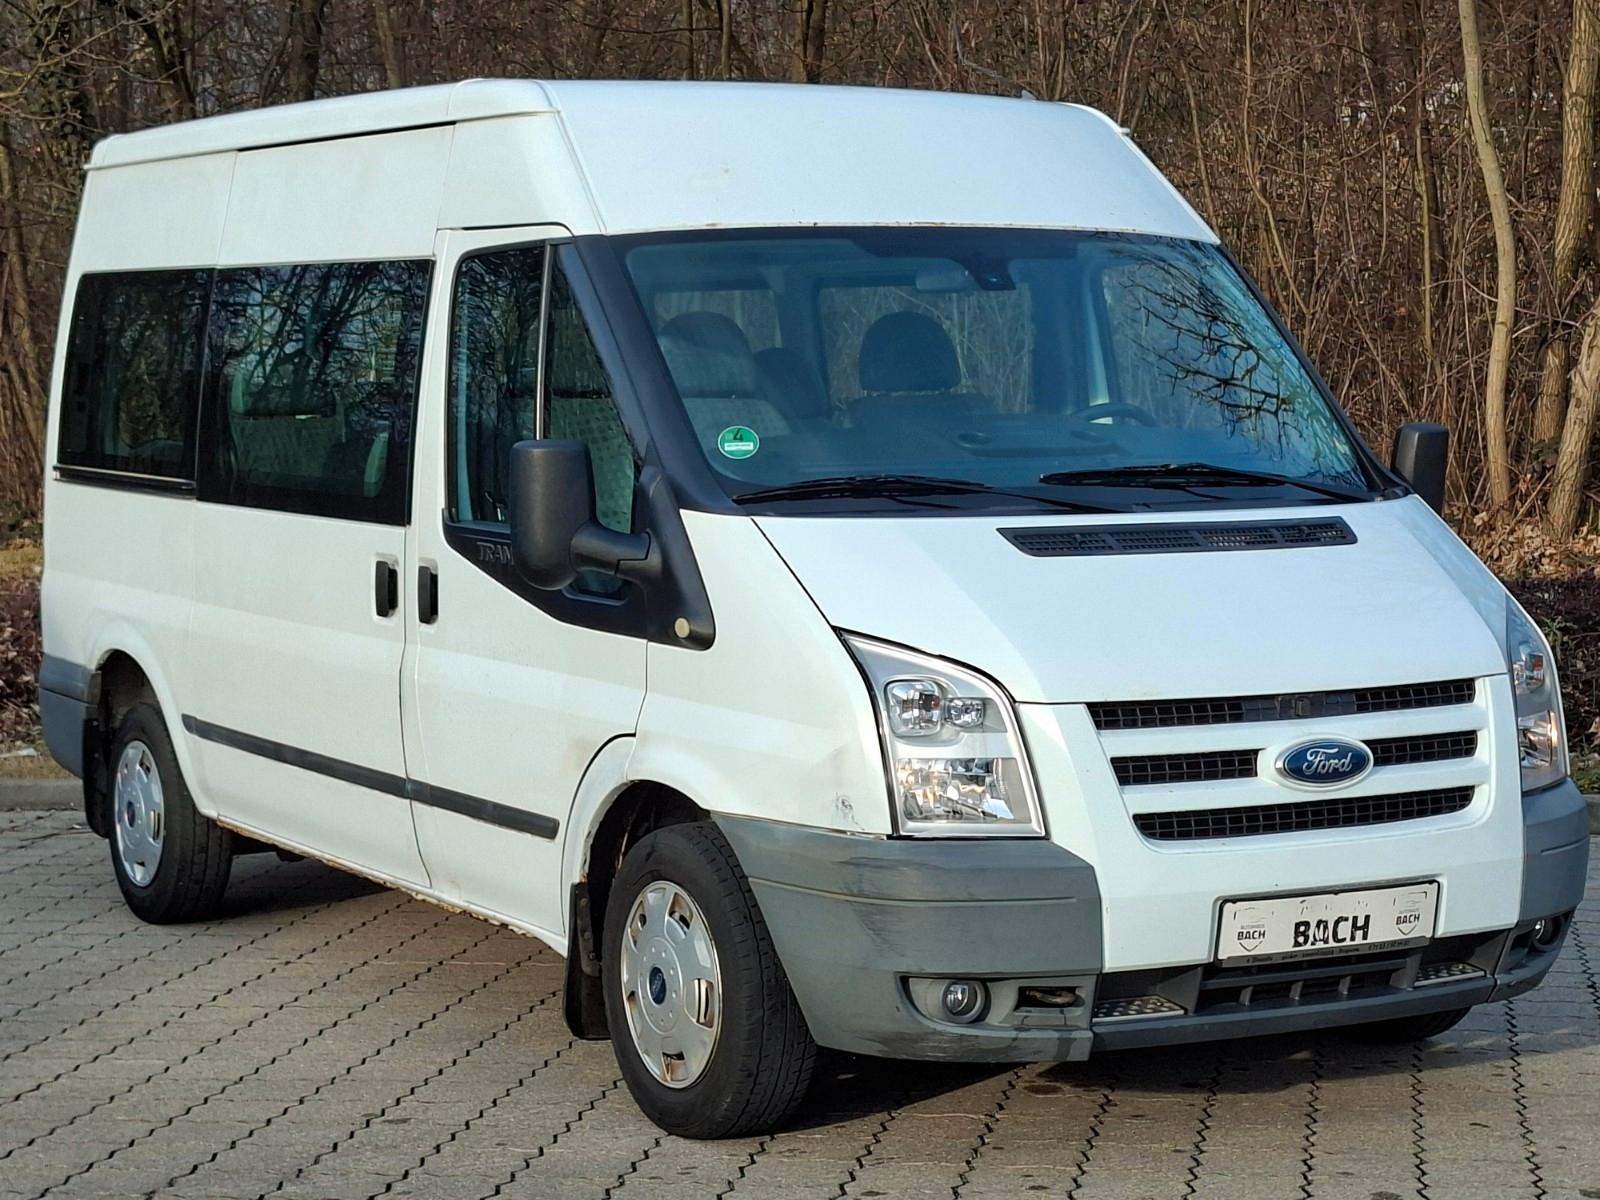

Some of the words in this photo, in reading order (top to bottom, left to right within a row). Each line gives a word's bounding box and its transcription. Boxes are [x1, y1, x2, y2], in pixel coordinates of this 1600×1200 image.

[733, 428, 744, 442] 4
[1302, 748, 1352, 775] Ford
[1396, 912, 1421, 926] BACH
[1237, 929, 1266, 941] BACH
[1292, 914, 1371, 949] BACH
